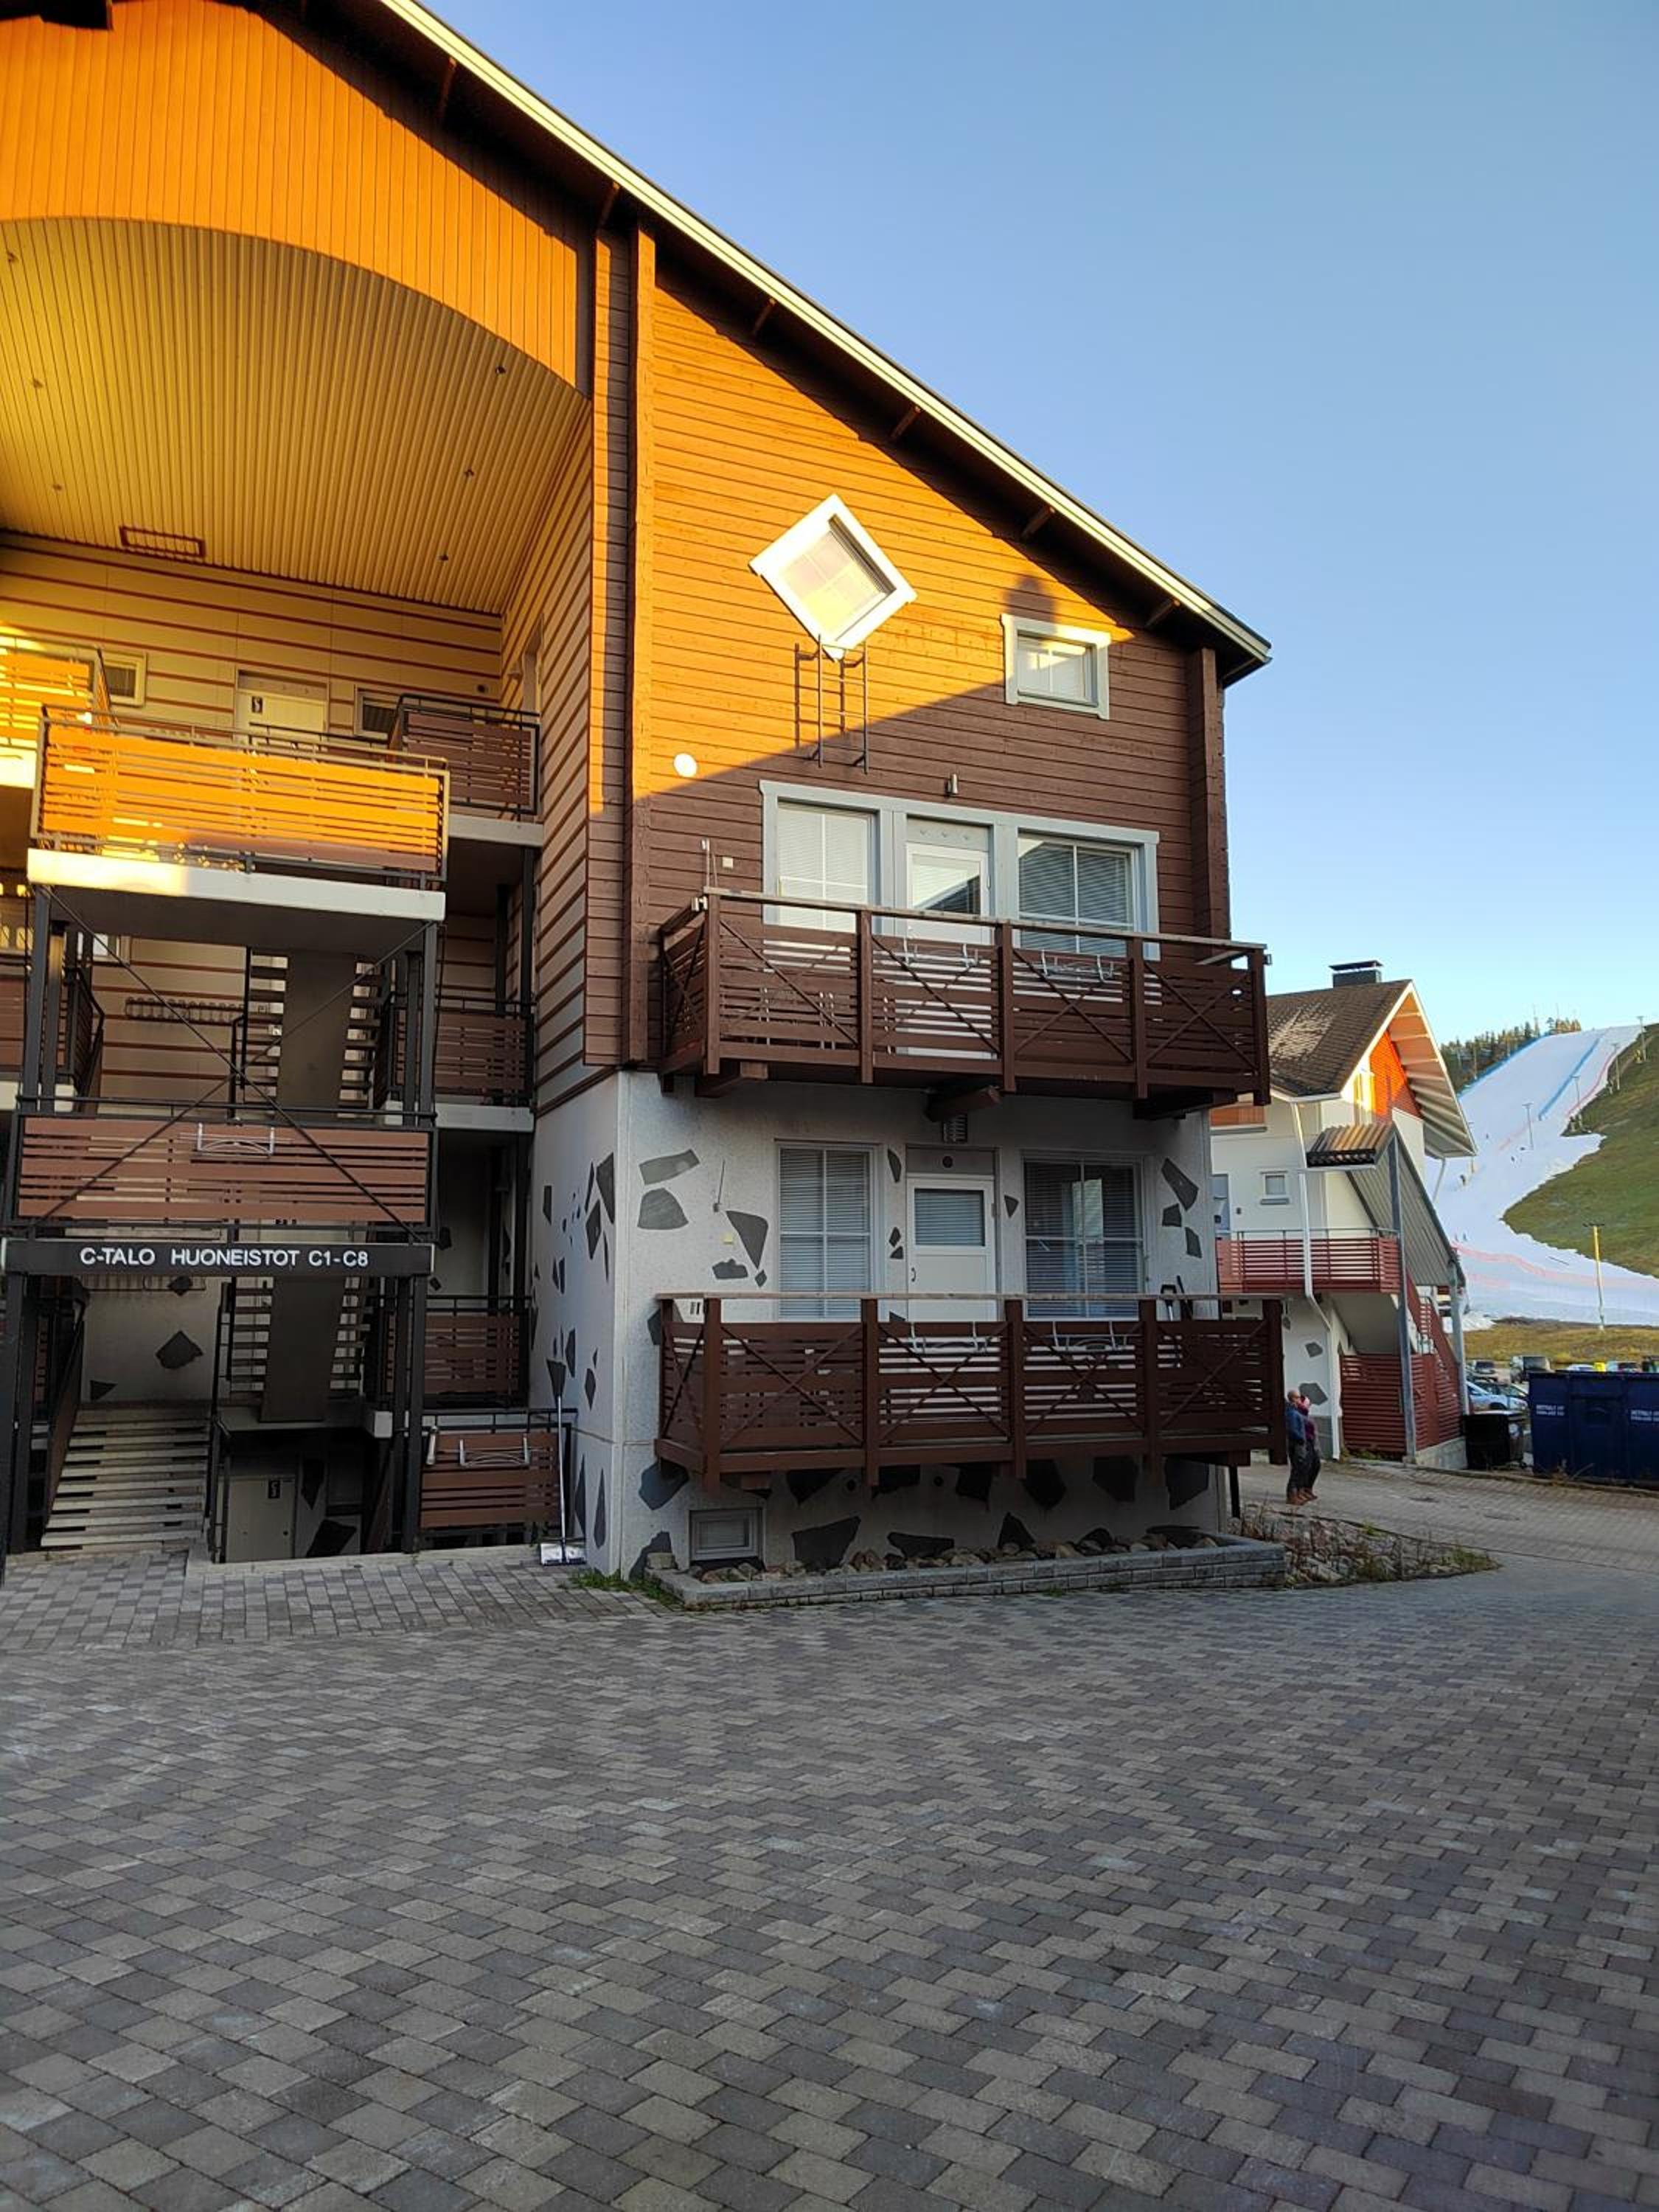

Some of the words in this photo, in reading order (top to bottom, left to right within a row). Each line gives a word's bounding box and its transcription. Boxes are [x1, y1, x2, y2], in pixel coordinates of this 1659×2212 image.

[80, 1247, 156, 1266] C-TALO
[170, 1248, 300, 1267] HUONEISTOT
[308, 1251, 368, 1267] C1-C8
